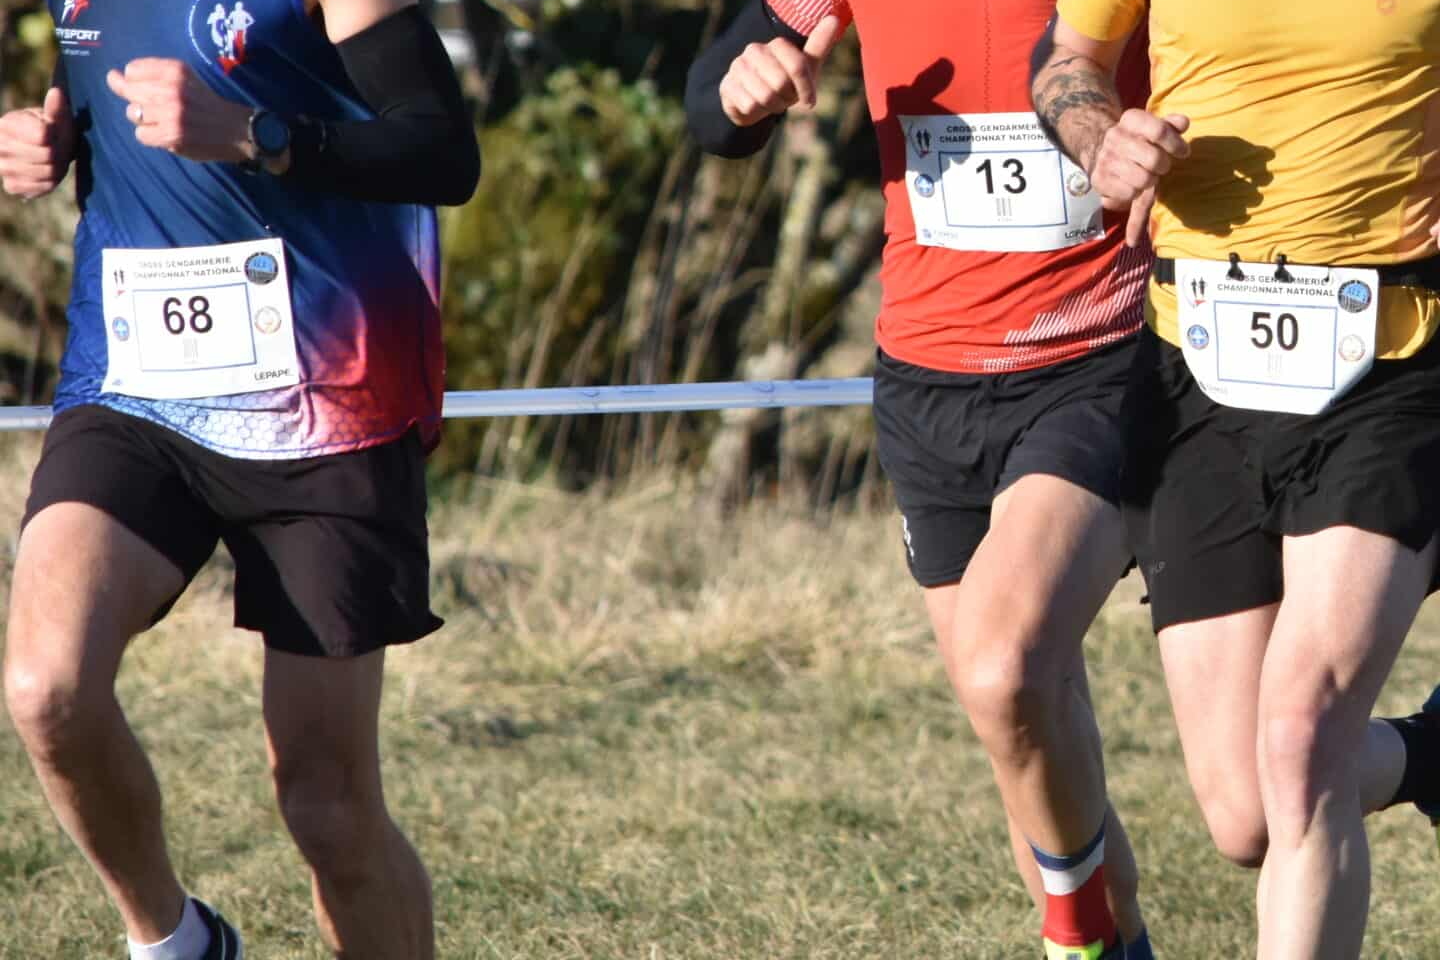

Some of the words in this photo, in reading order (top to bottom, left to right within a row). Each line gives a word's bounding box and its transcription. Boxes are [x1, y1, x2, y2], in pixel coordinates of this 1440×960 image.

[946, 125, 976, 134] CROSS
[979, 123, 1042, 132] GENDARMER
[939, 133, 1006, 143] CHAMPIONNAT
[1009, 133, 1050, 141] NATION
[975, 158, 1027, 194] 13
[165, 256, 232, 269] GENDARMERIE
[193, 266, 242, 278] NATIONAL
[1217, 283, 1285, 295] CHAMPIONNAT
[1286, 287, 1336, 298] NATIONAL
[163, 295, 213, 335] 68
[1250, 311, 1299, 351] 50
